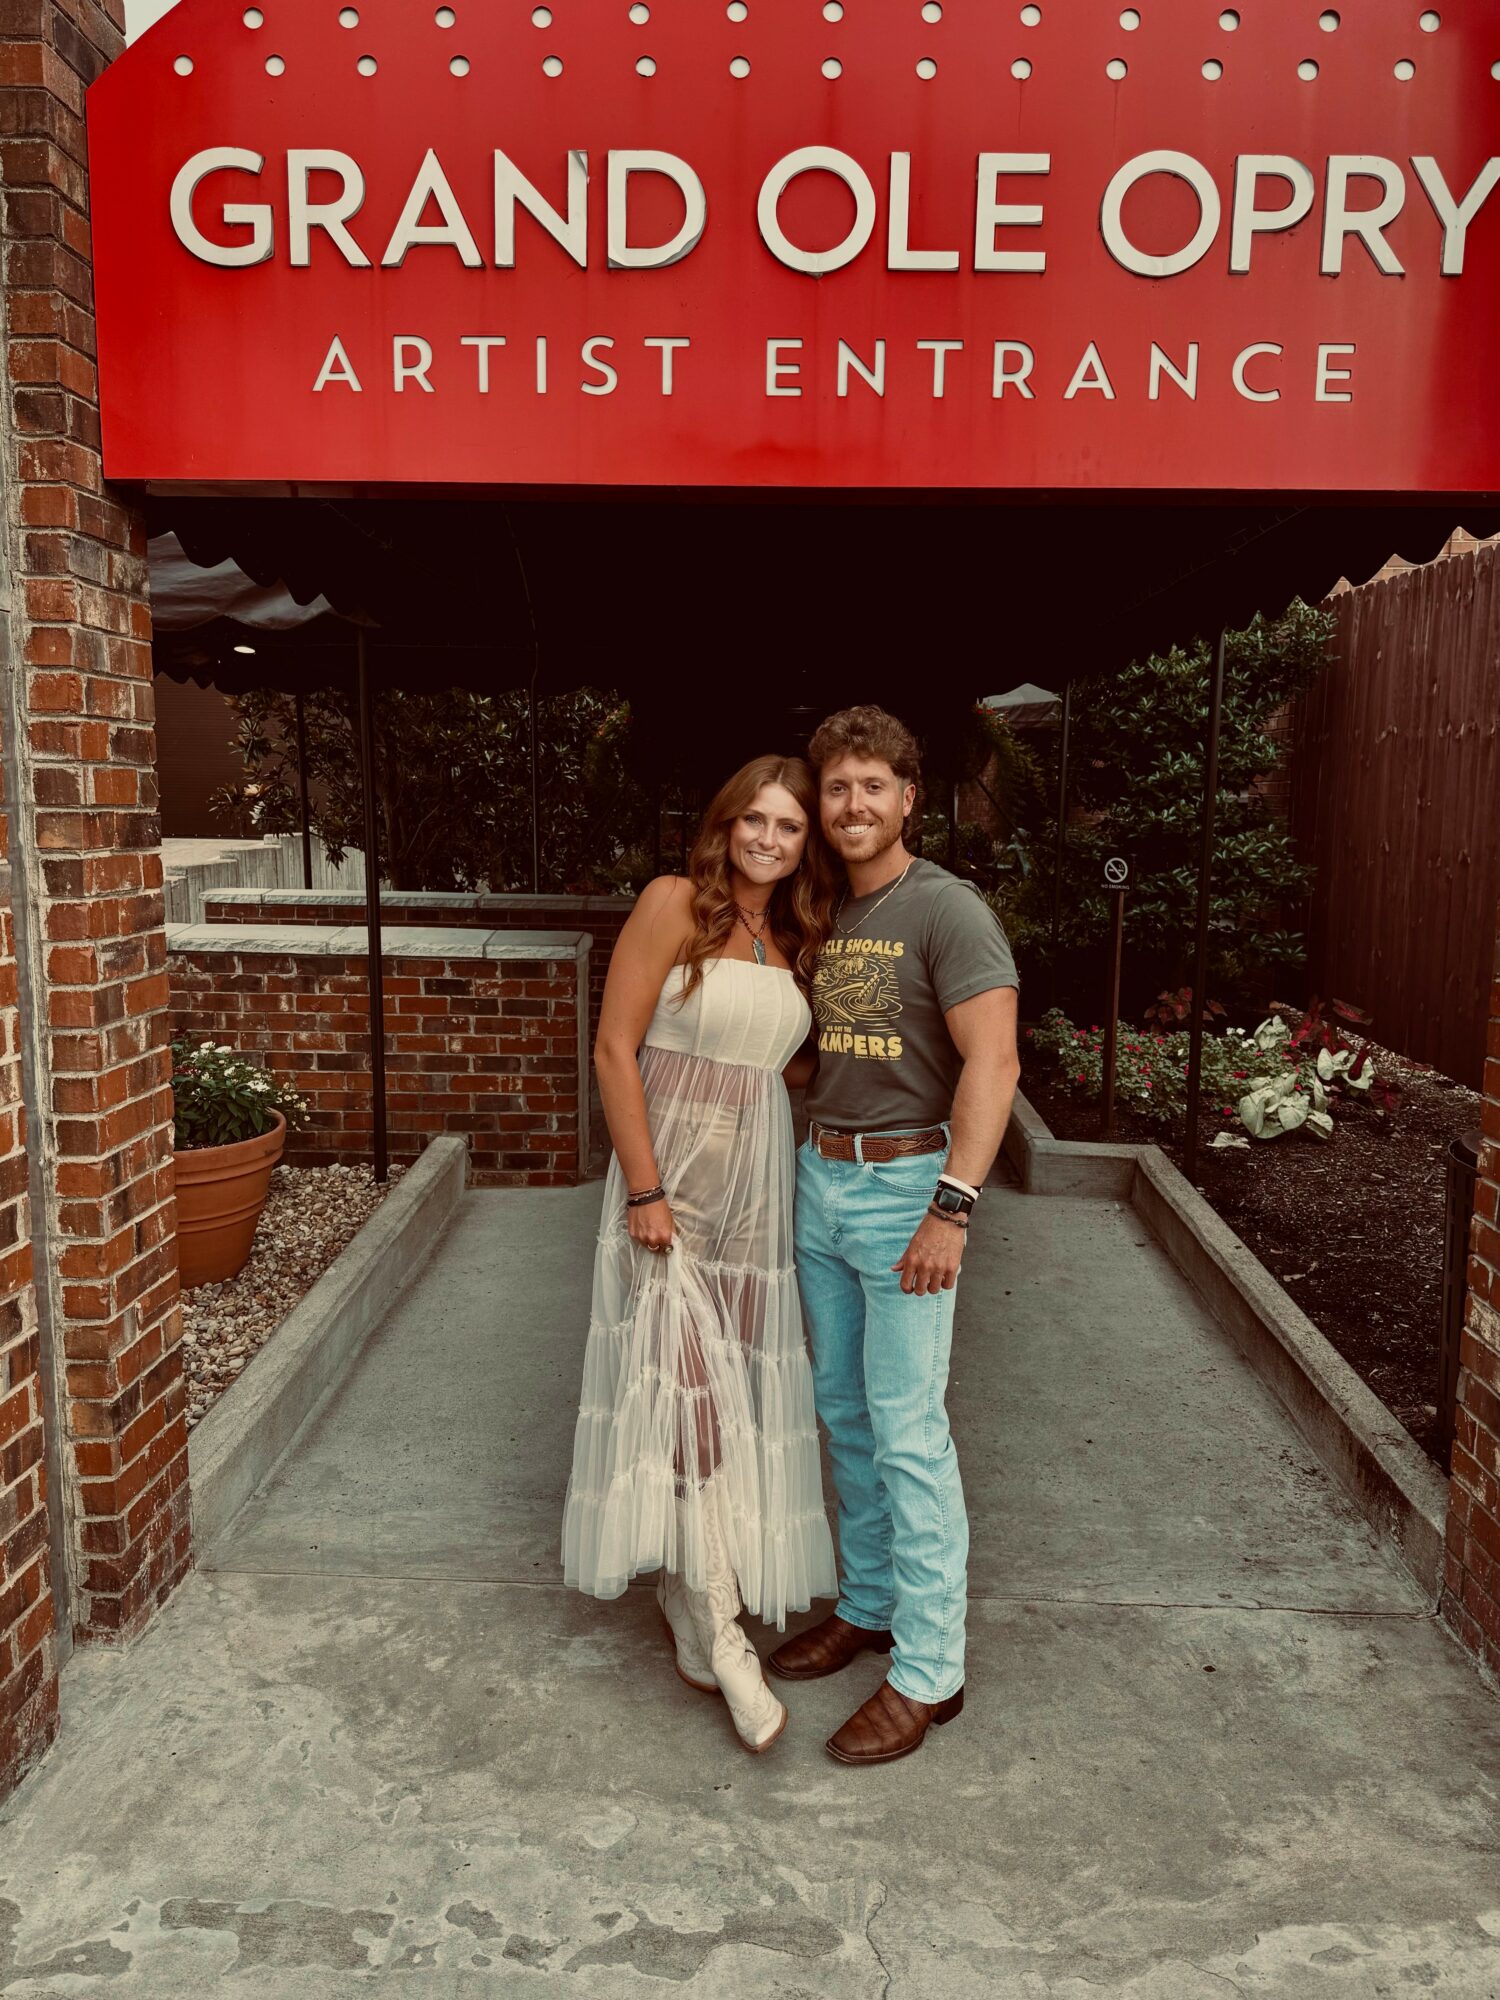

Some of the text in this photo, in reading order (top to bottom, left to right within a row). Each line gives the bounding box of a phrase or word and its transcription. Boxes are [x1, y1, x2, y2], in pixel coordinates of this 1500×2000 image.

[169, 146, 1500, 277] GRAND OLE OPRY
[312, 335, 1355, 402] ARTIST ENTRANCE
[845, 938, 905, 957] SHOALS
[818, 1032, 903, 1058] AMPERS
